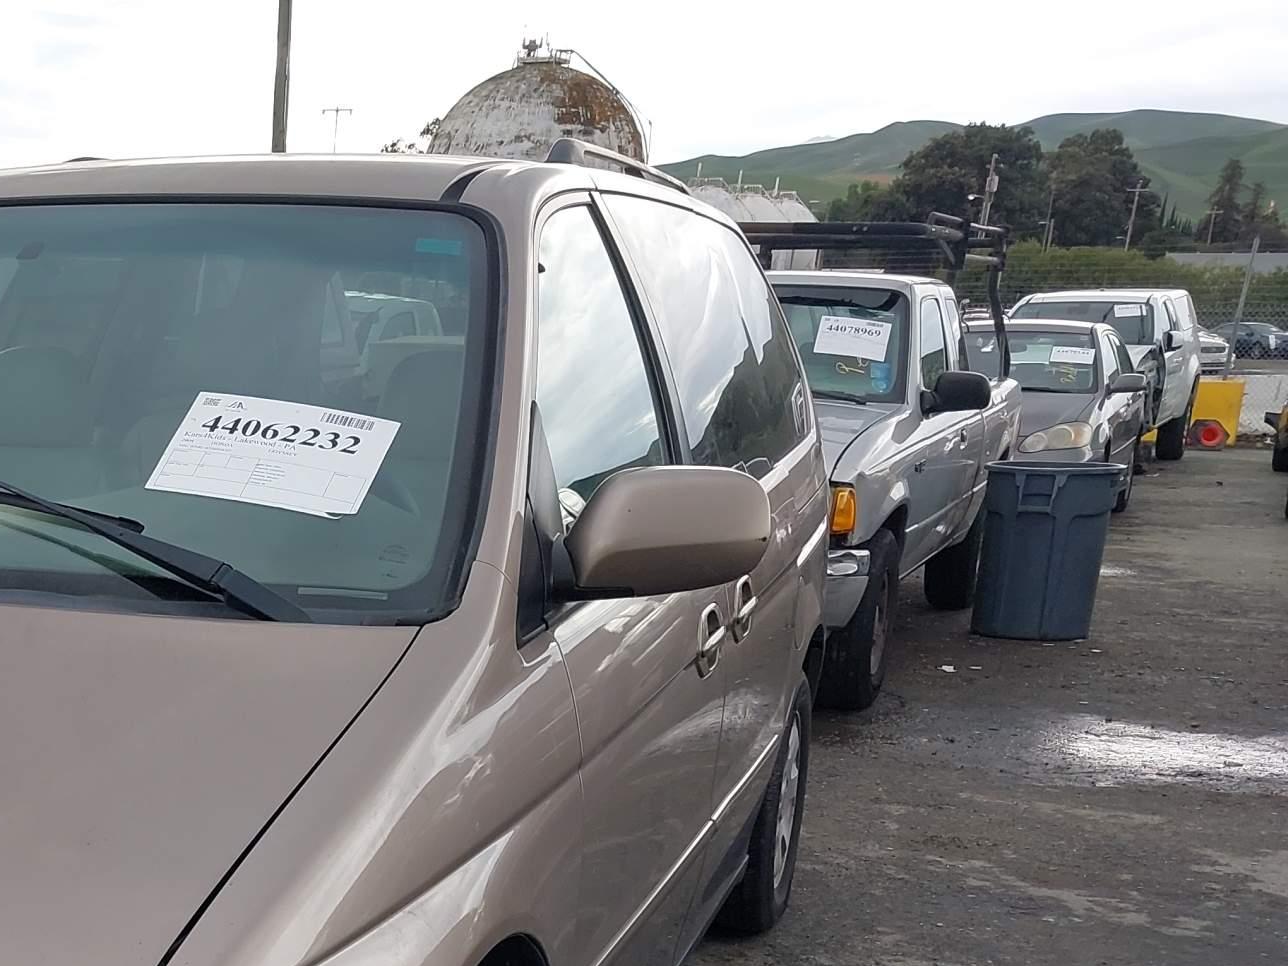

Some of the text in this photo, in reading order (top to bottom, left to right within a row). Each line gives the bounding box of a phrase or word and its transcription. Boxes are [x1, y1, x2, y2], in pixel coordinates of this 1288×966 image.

[826, 324, 881, 337] 44078969
[201, 415, 361, 455] 44062232
[233, 436, 277, 448] Lakewood
[283, 443, 296, 451] PA
